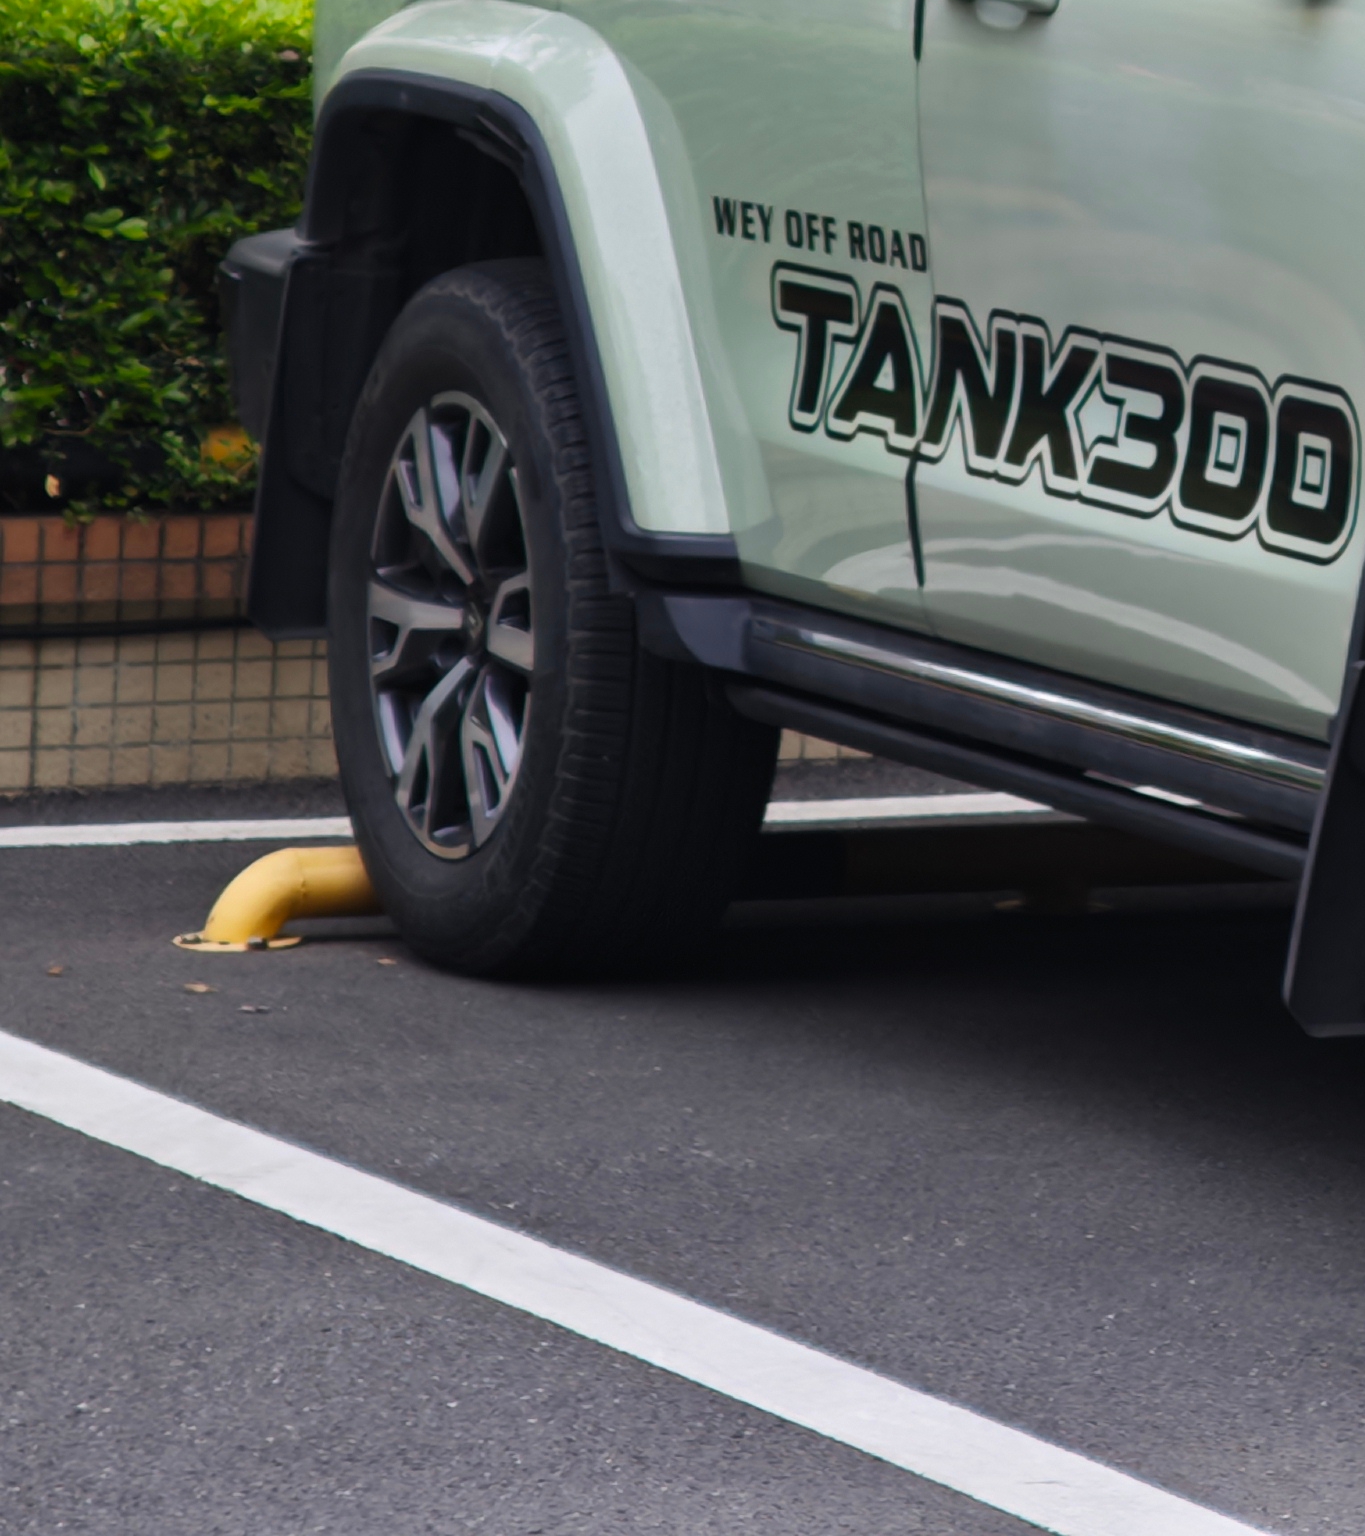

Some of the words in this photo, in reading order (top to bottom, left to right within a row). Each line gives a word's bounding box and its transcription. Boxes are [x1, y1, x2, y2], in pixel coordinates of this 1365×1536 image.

[711, 195, 773, 244] WEY
[785, 208, 838, 256] OFF
[848, 219, 928, 274] ROAD
[769, 259, 1364, 568] TANK300
